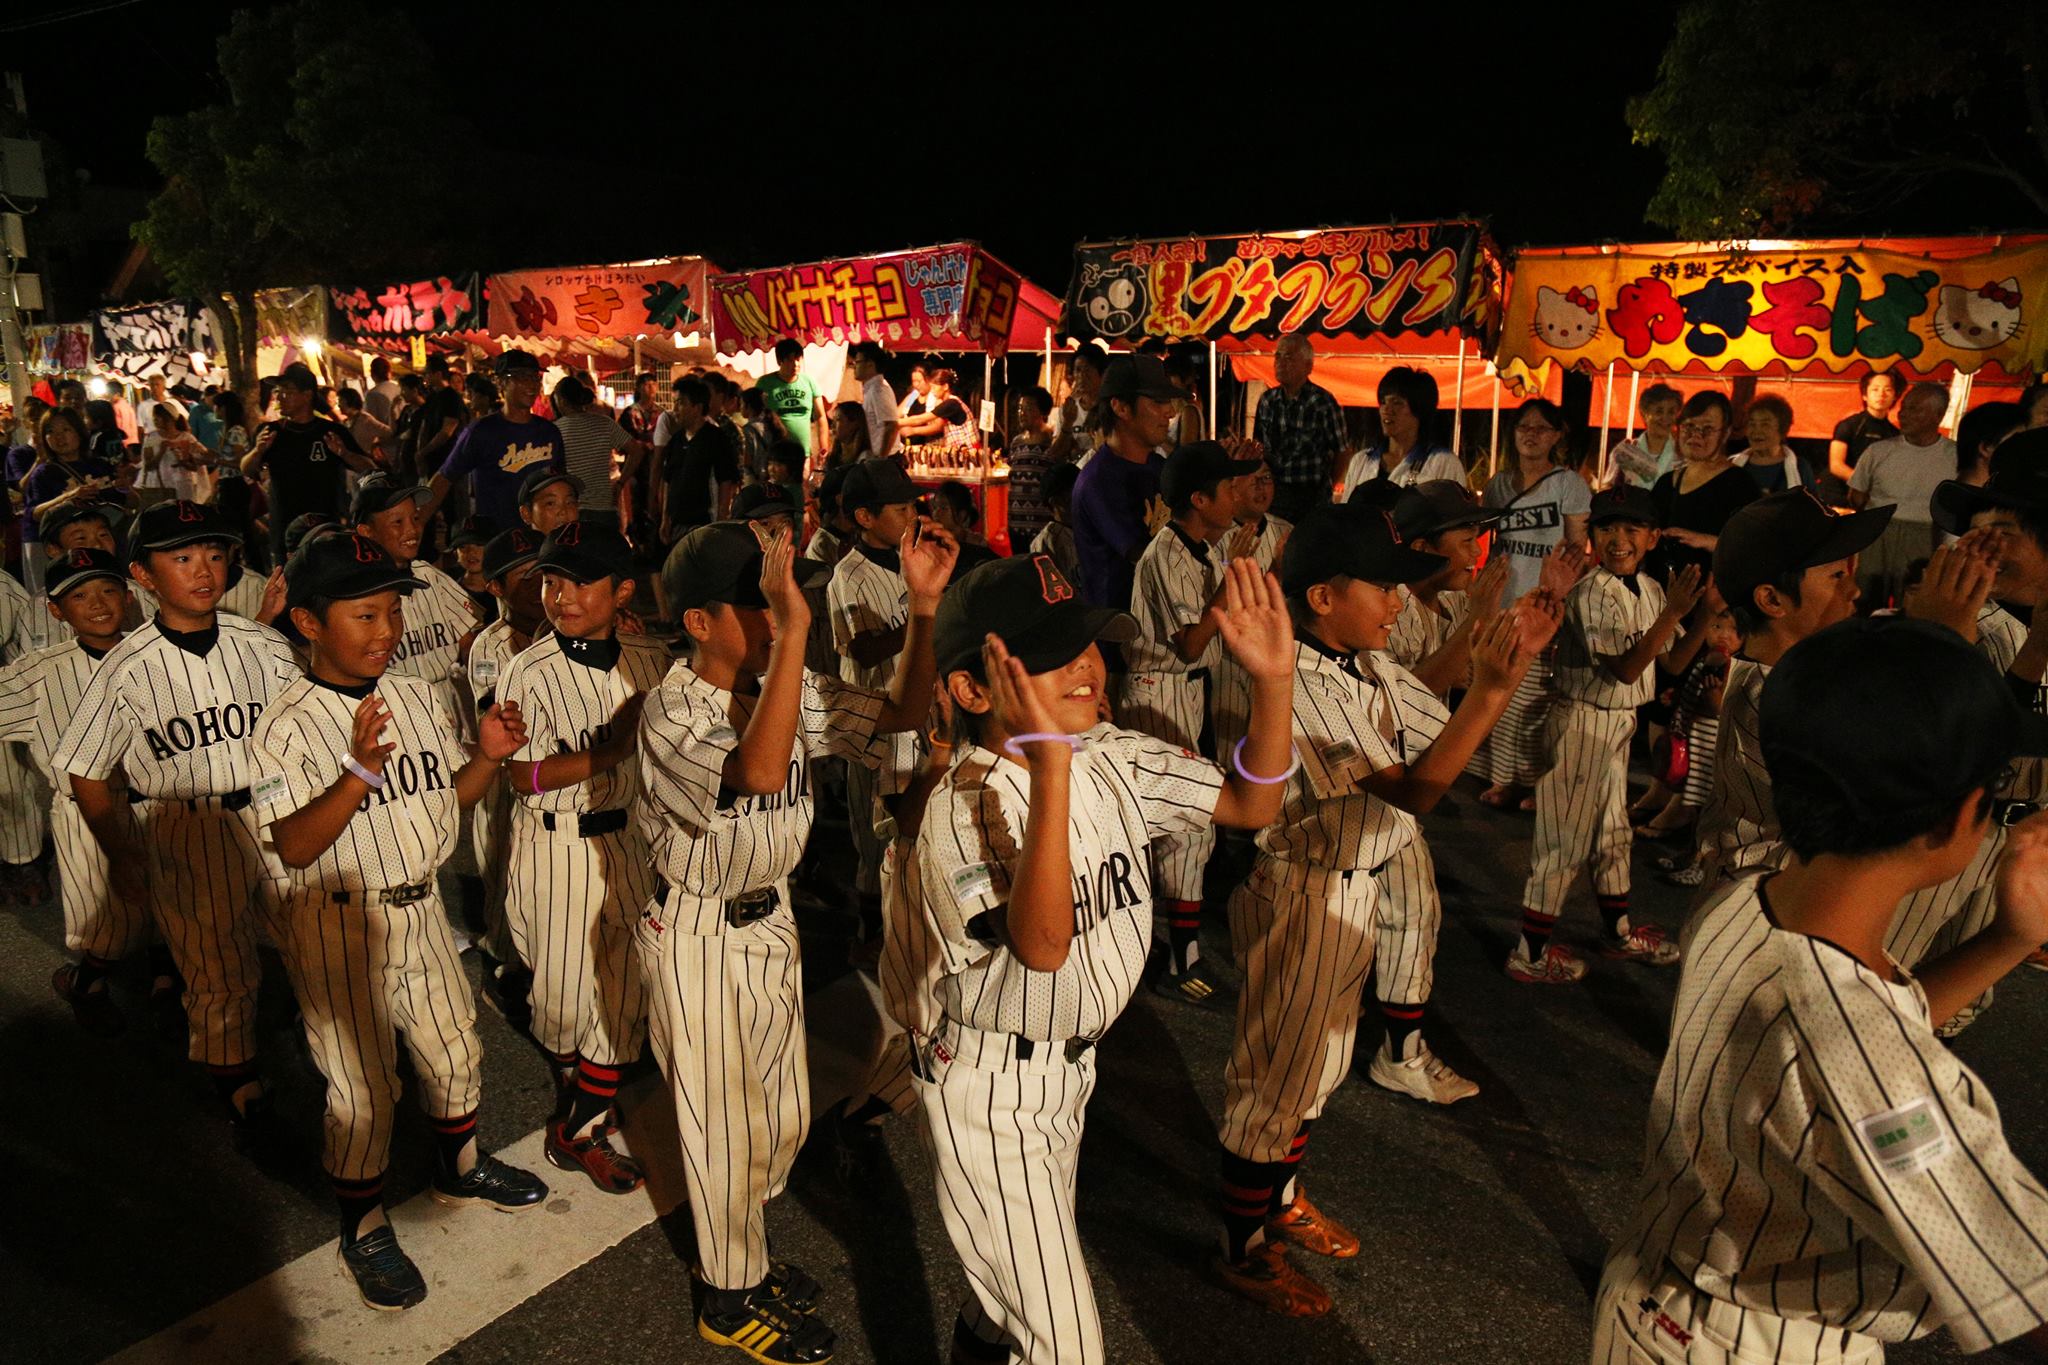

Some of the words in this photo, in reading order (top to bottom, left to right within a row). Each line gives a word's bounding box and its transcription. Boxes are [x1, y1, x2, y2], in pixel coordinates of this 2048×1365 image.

[904, 253, 966, 287] じゃんけん
[1650, 255, 1867, 280] 特製スパイス入
[764, 261, 908, 332] バナナチョコ
[1143, 246, 1457, 337] 黒ブタフランク
[510, 280, 701, 334] かき氷
[1605, 270, 1940, 360] やきそば
[775, 389, 806, 402] UNDER
[309, 440, 328, 462] A
[177, 500, 205, 523] A
[555, 522, 580, 546] A
[71, 547, 95, 569] A
[352, 533, 384, 563] A
[1033, 554, 1074, 605] A
[648, 917, 665, 935] SSK
[934, 1044, 952, 1064] SSK
[1656, 1312, 1694, 1347] SSK
